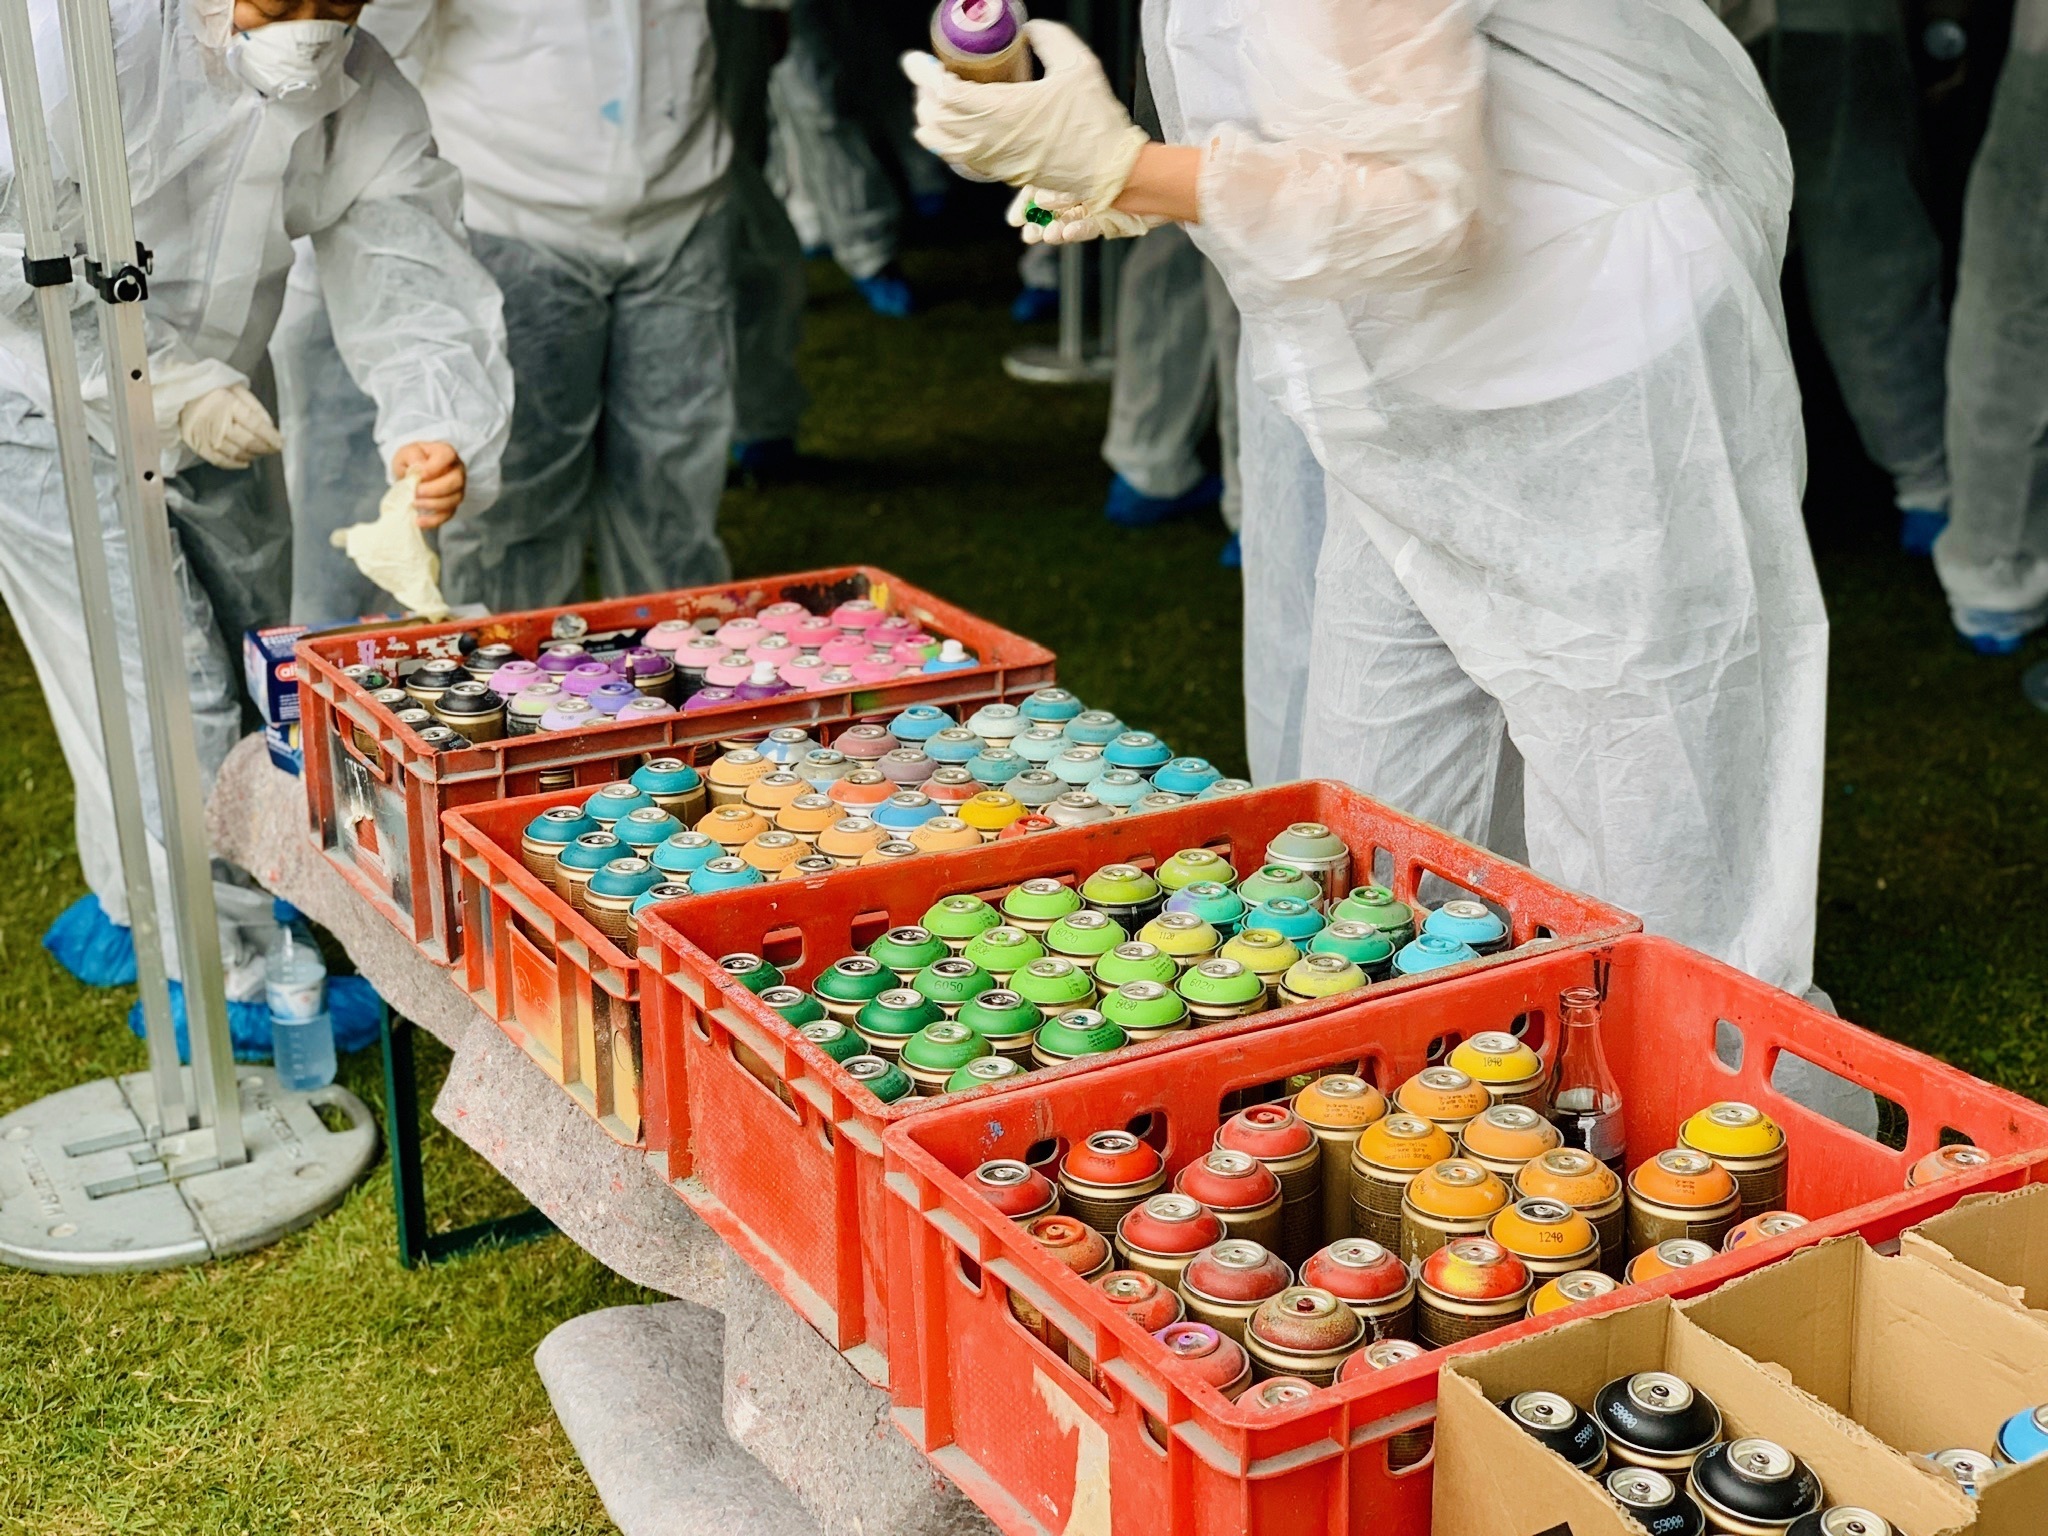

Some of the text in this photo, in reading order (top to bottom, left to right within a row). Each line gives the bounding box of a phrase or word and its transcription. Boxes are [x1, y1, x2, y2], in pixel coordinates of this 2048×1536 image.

[934, 980, 964, 993] 6050
[1483, 1056, 1503, 1068] 1040
[1538, 1231, 1564, 1244] 1240
